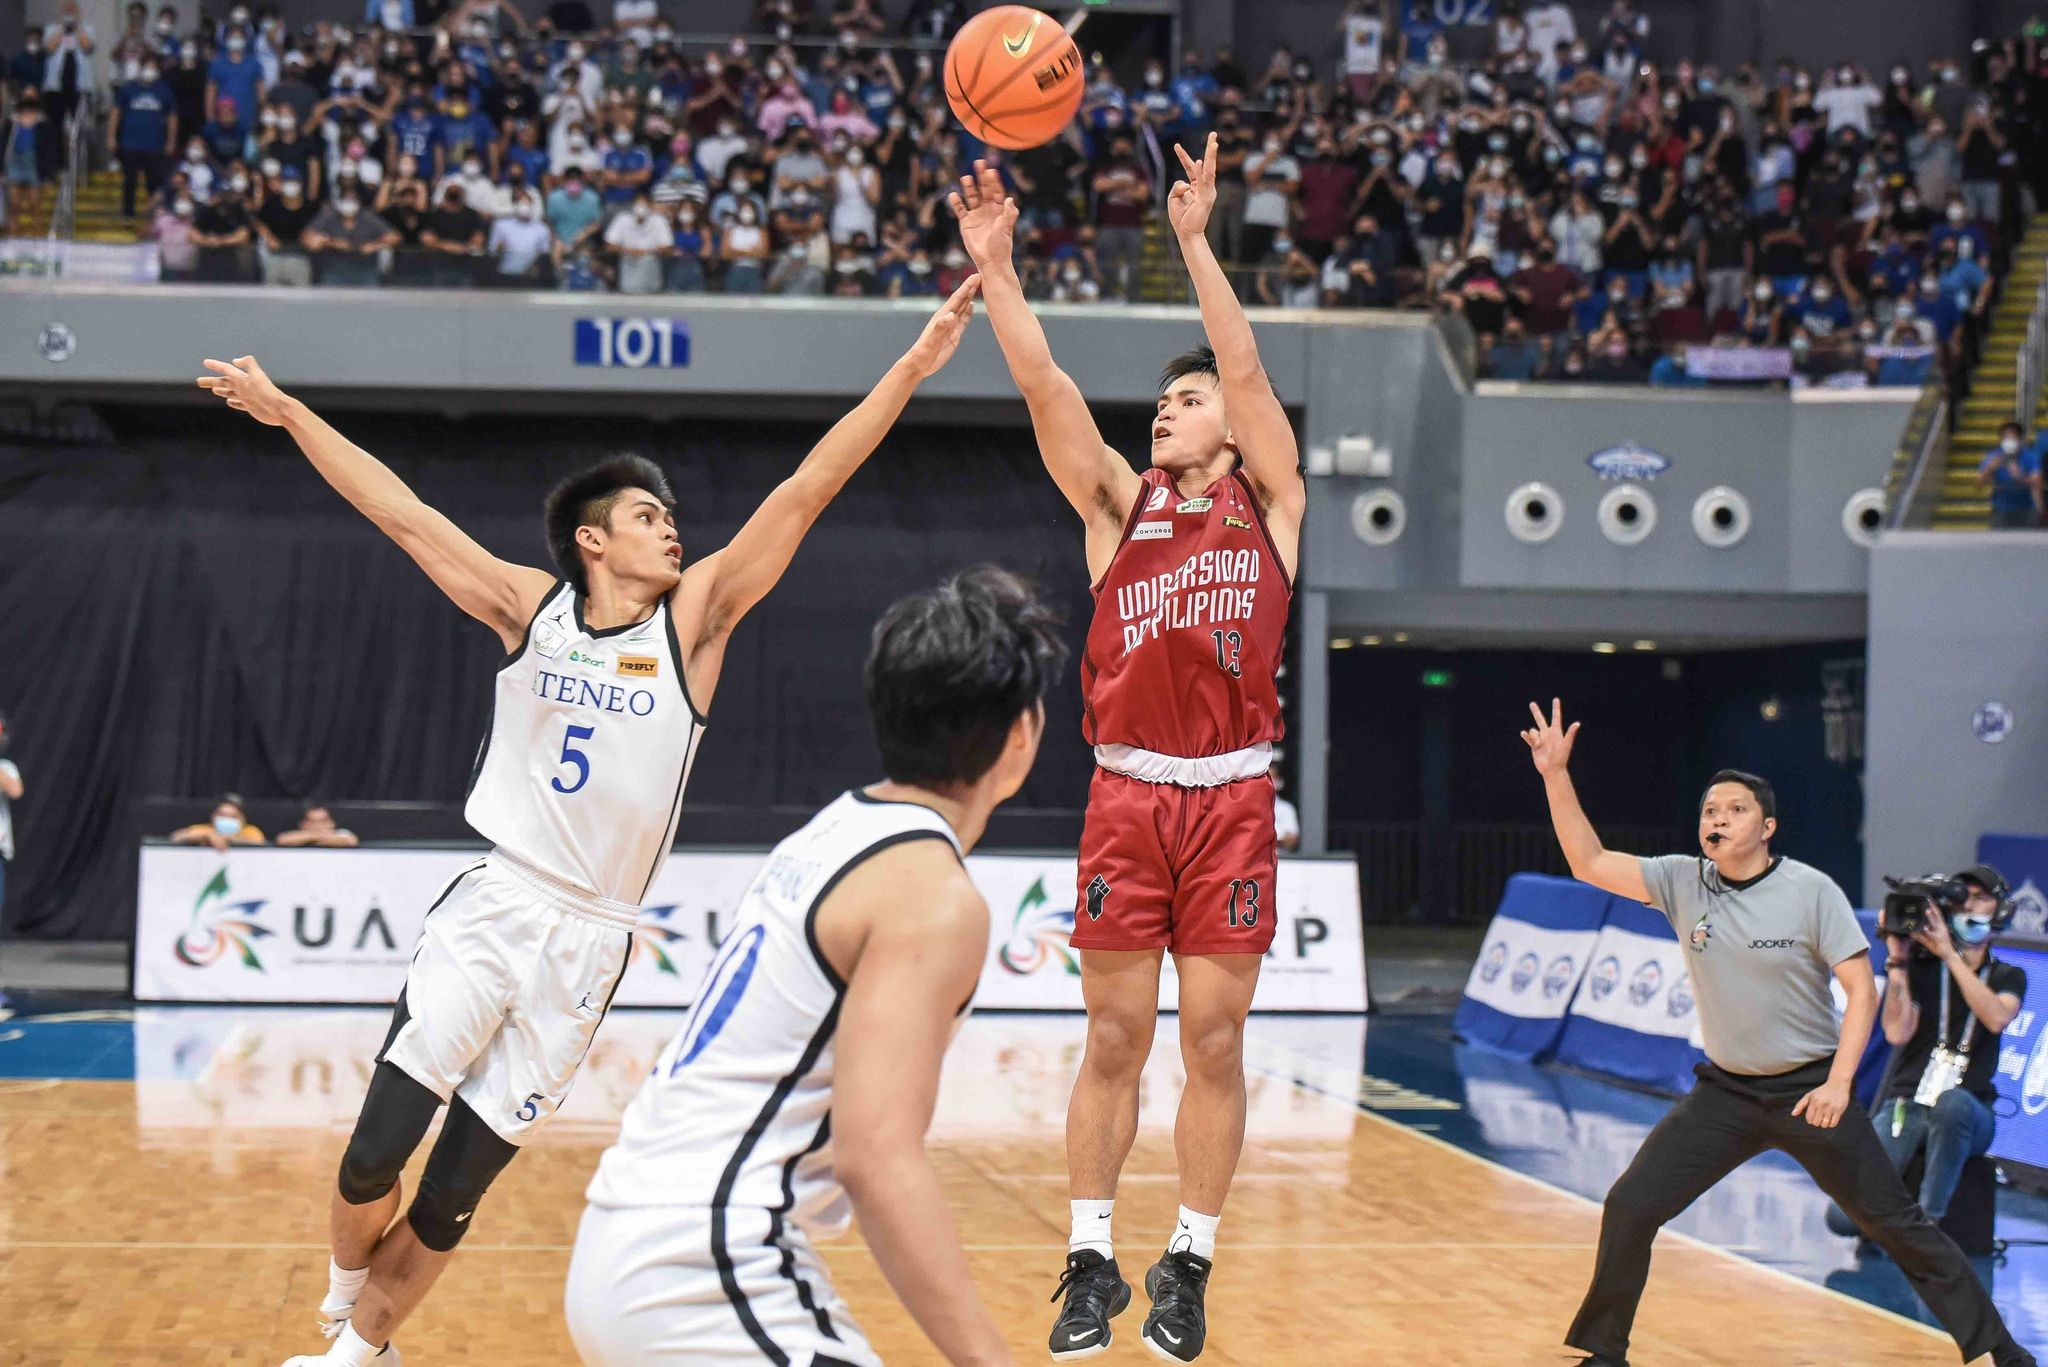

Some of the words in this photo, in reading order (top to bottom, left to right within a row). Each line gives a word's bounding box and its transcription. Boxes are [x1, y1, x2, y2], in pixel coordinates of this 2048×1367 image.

[1434, 0, 1488, 26] 02
[593, 318, 672, 367] 101
[1135, 527, 1172, 535] CONVERGE
[579, 653, 607, 669] Smart
[619, 661, 656, 672] FIREFLY
[1211, 629, 1243, 679] 13
[532, 670, 655, 716] TENEO
[551, 724, 595, 794] 5
[1227, 878, 1260, 928] 13
[293, 906, 397, 950] UA
[1747, 938, 1795, 950] JOCKEY
[515, 1092, 545, 1122] 5
